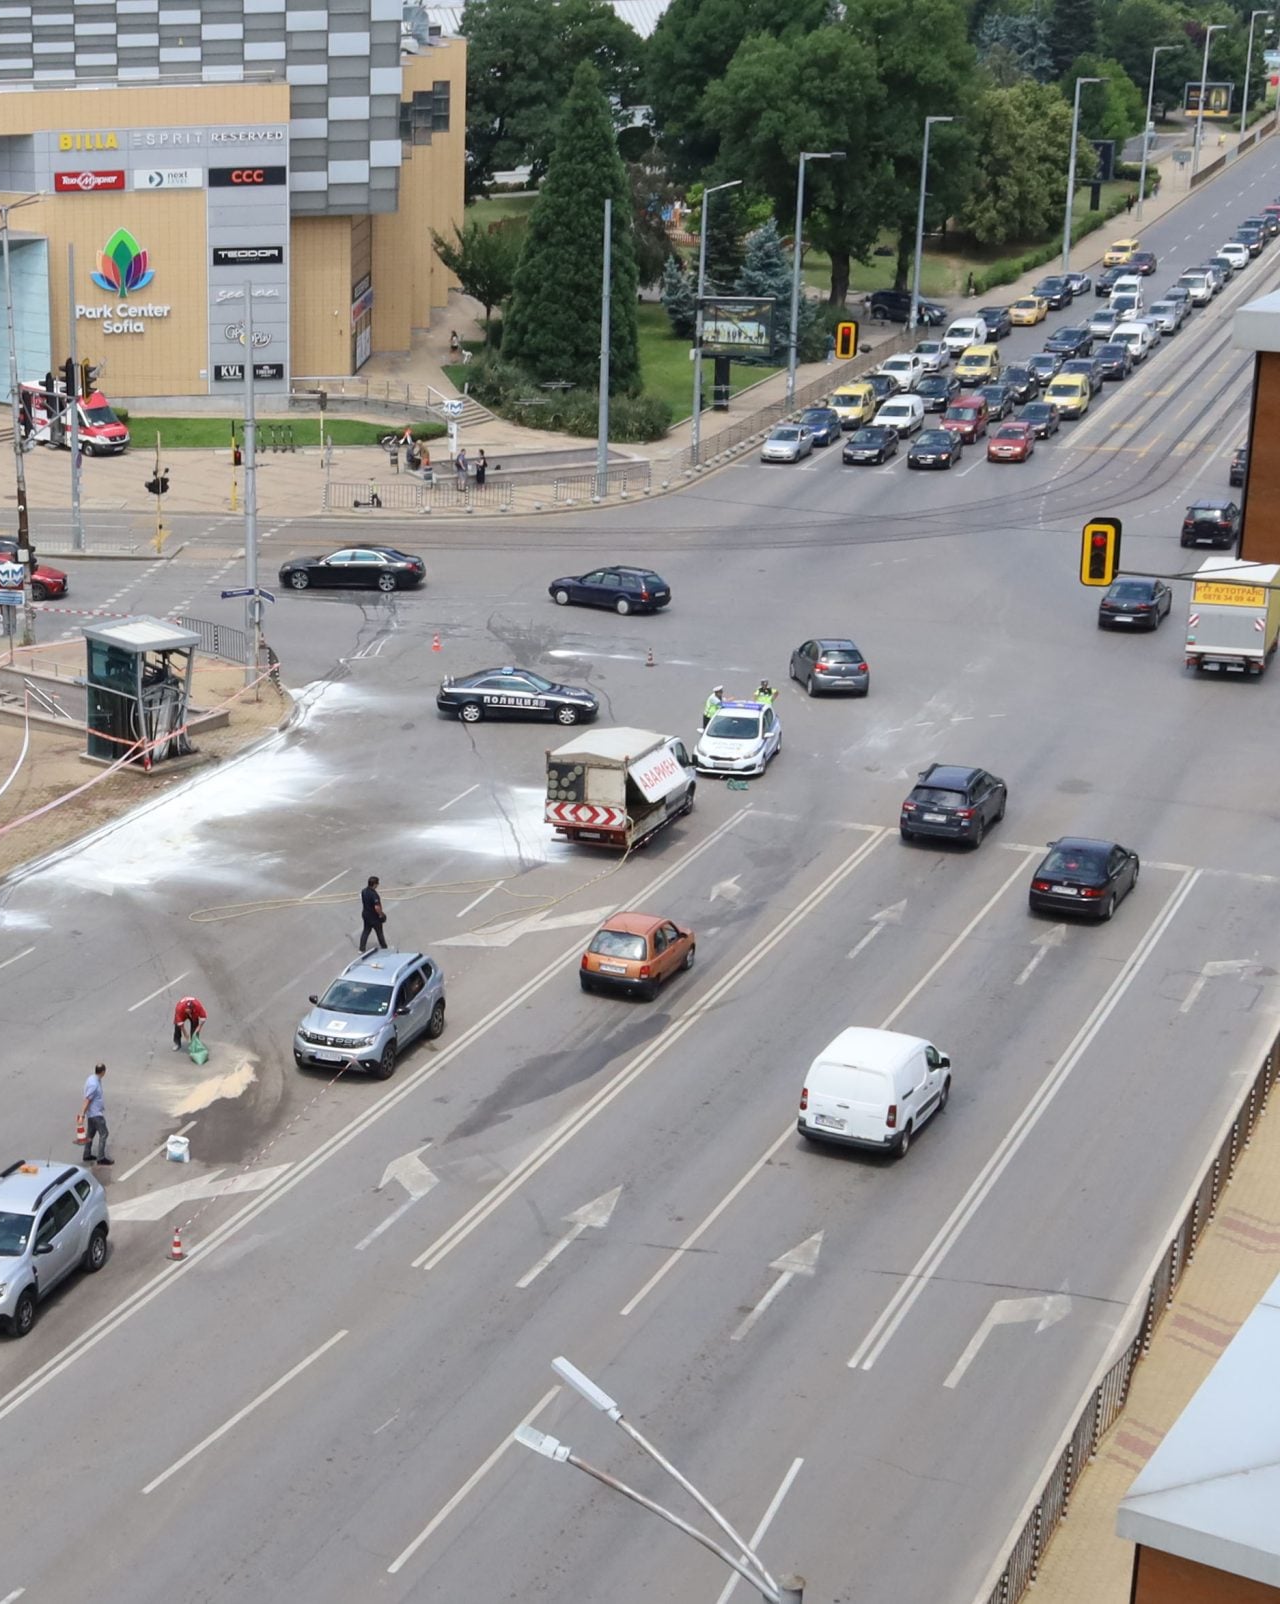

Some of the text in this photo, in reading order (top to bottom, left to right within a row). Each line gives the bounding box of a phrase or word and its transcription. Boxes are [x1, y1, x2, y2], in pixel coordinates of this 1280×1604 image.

[59, 132, 119, 151] BILLA
[133, 132, 203, 146] ESPRIT
[211, 130, 283, 142] RESERVED
[231, 170, 264, 183] CCC
[75, 303, 170, 319] Park Center
[103, 319, 144, 334] Sofia
[221, 365, 242, 376] KVL
[483, 695, 539, 706] ПОЛИЦИЯ
[639, 757, 679, 790] АВАРИЕН
